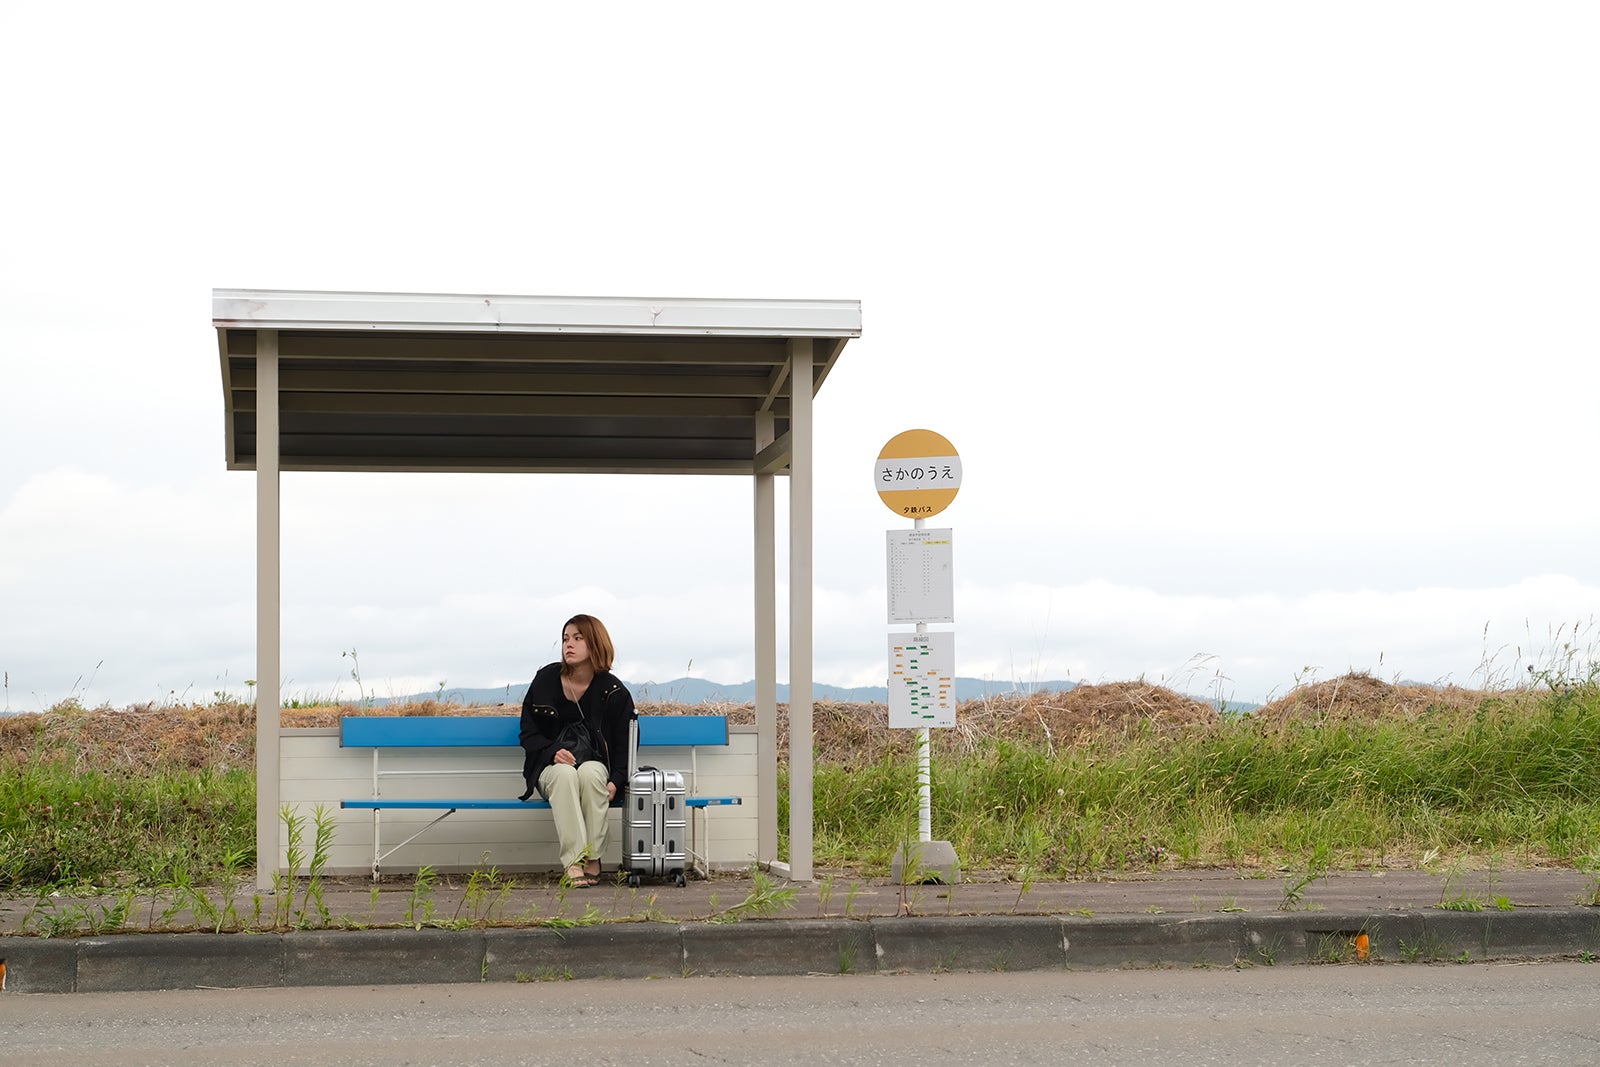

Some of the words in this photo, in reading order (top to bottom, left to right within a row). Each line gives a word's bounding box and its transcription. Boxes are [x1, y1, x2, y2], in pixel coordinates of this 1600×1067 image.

[882, 466, 954, 482] さかのうえ
[903, 506, 932, 514] 夕鉄バス
